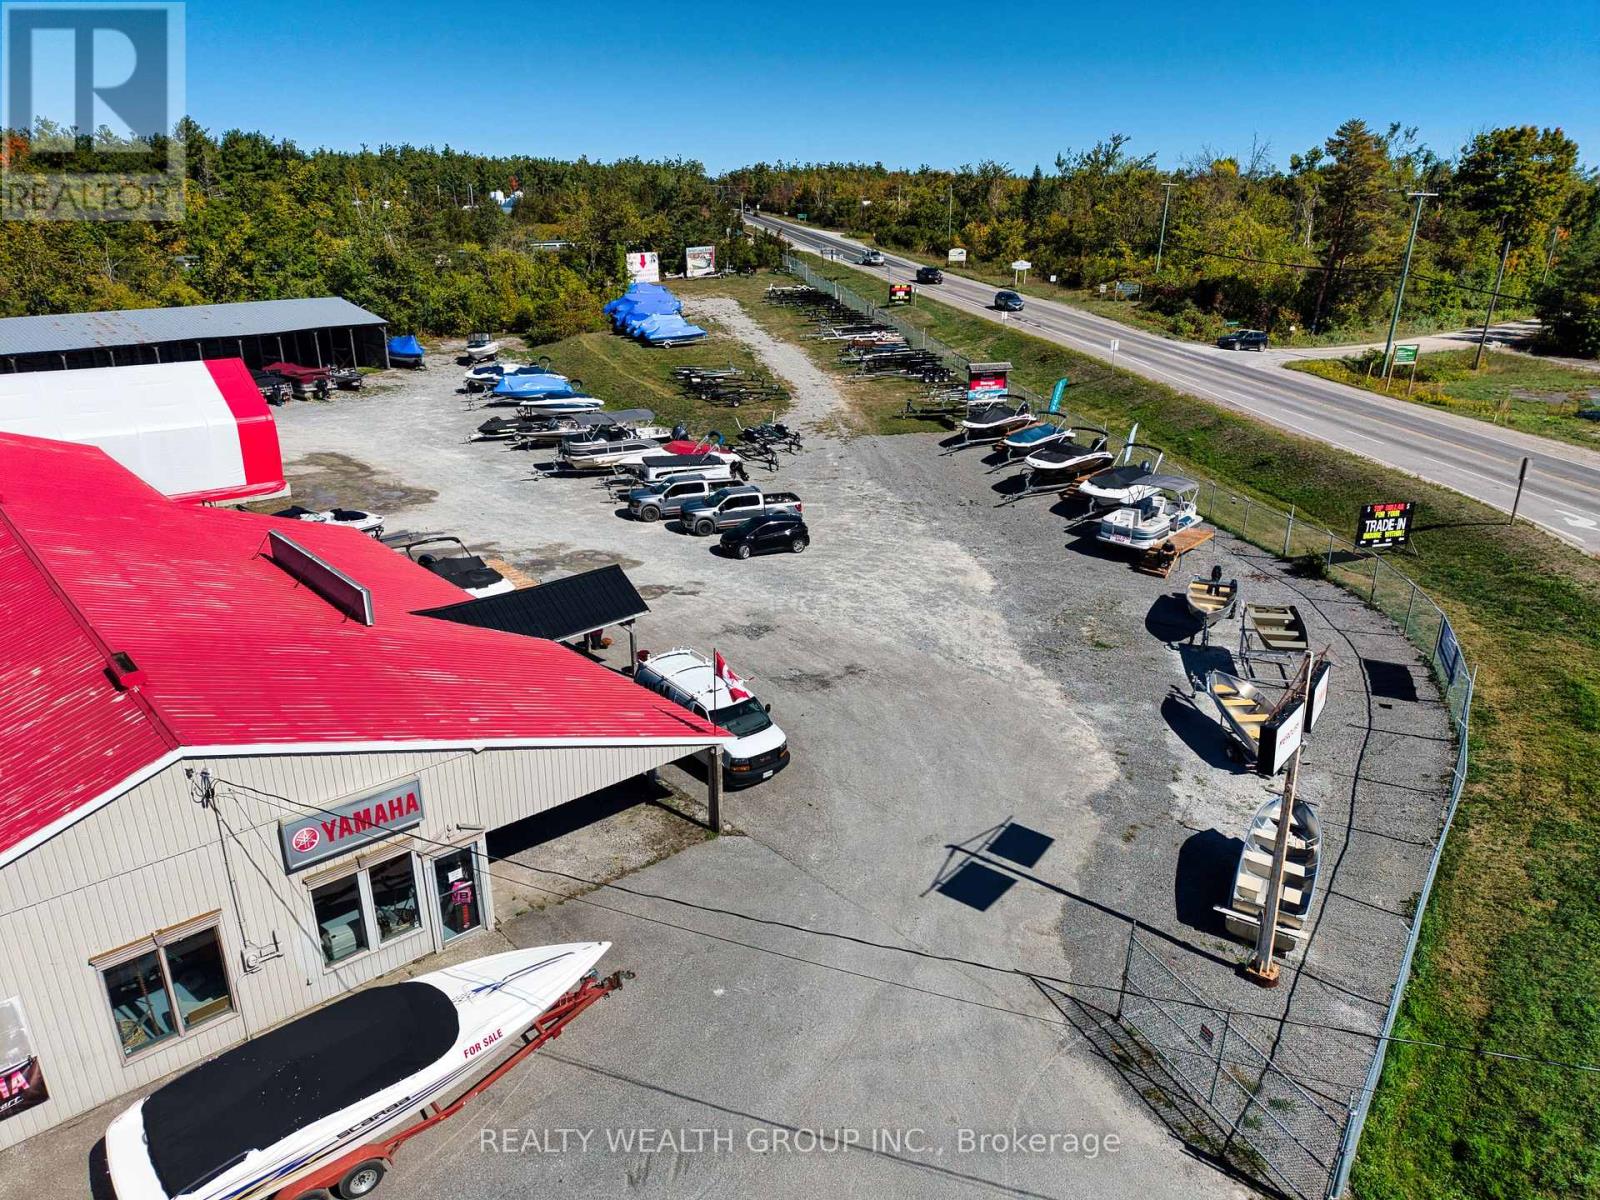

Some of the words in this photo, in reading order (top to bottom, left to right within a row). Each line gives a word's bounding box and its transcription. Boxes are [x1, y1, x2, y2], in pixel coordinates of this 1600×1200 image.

[1365, 517, 1406, 532] TRADE-IN
[321, 791, 420, 843] YAMAHA
[463, 1042, 482, 1059] FOR
[483, 1028, 504, 1047] SALE
